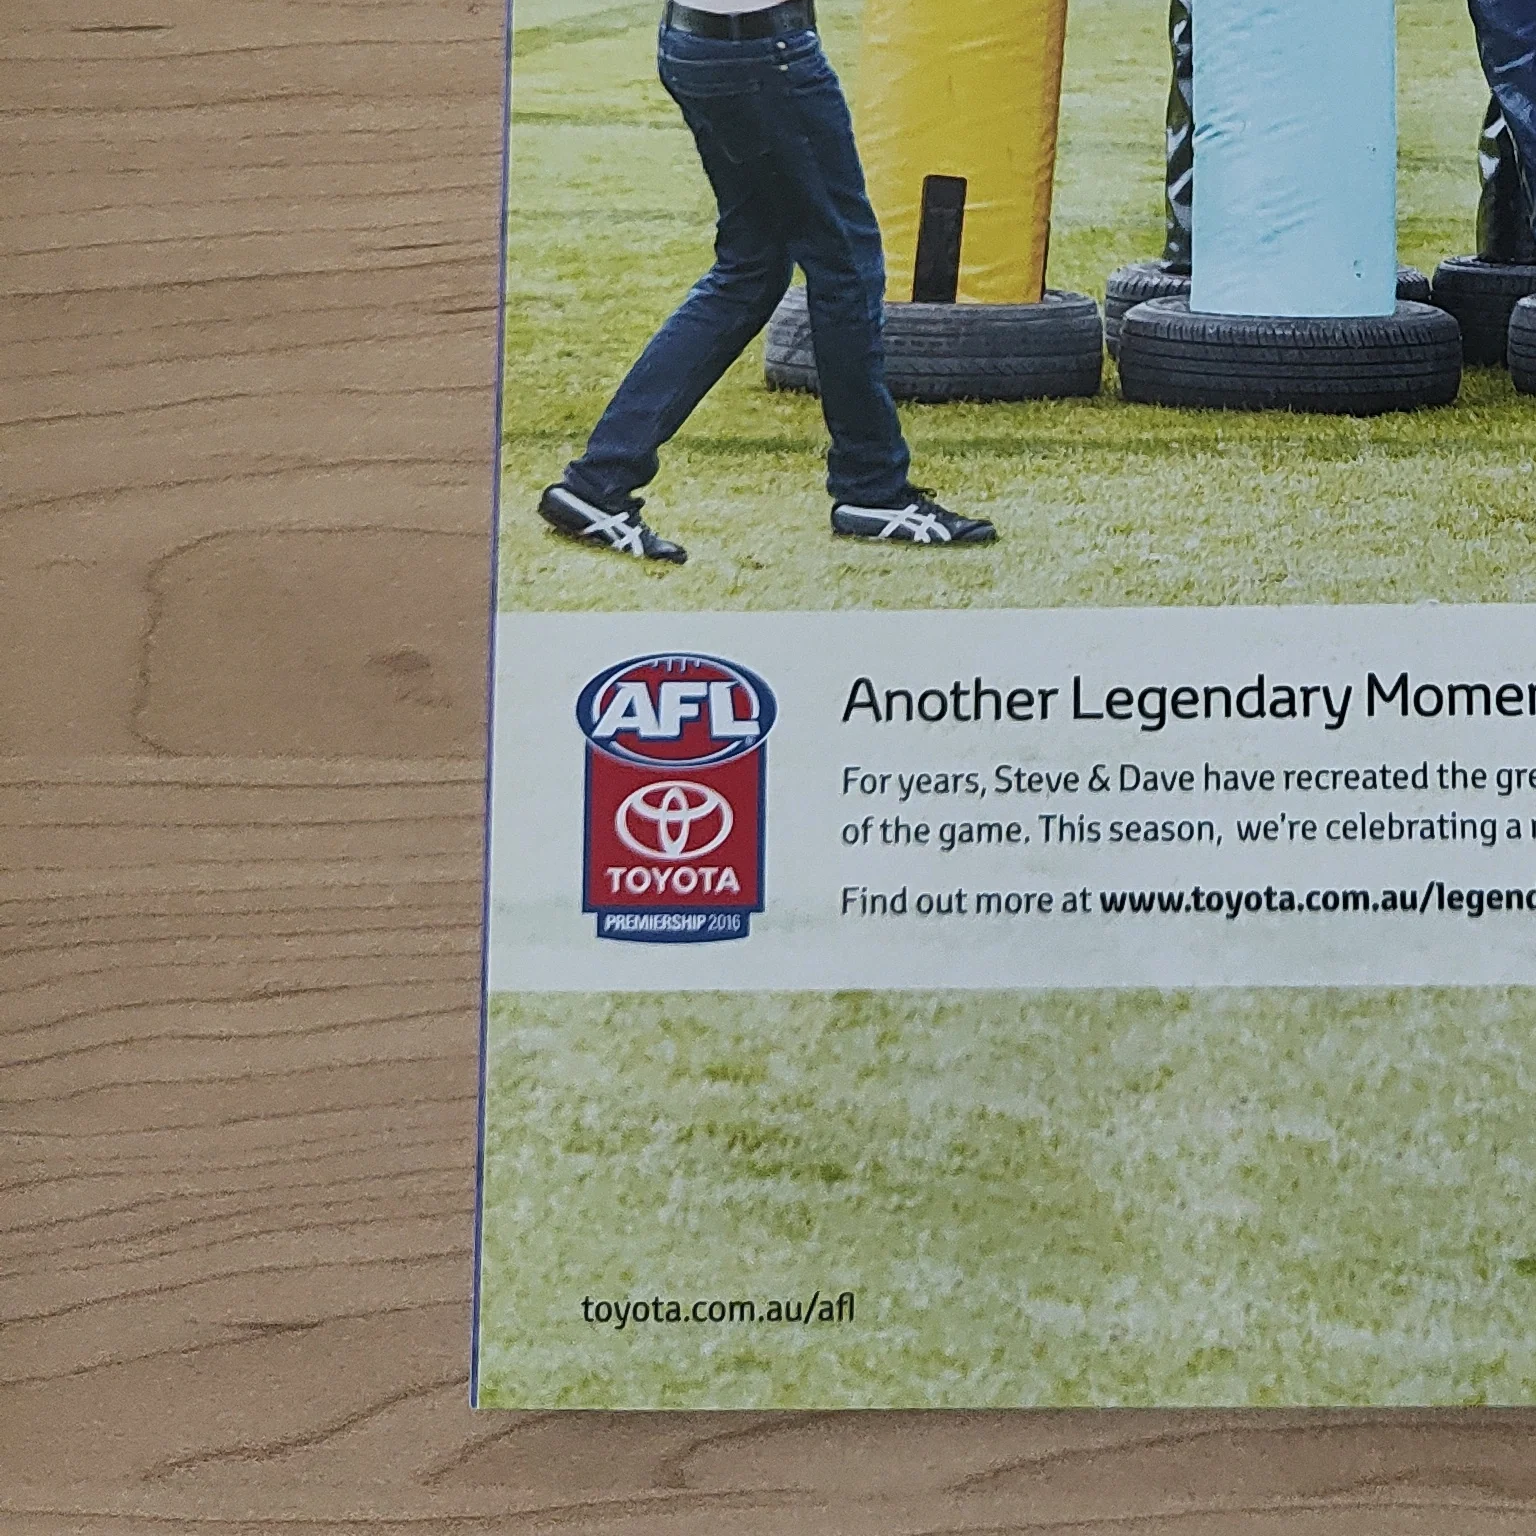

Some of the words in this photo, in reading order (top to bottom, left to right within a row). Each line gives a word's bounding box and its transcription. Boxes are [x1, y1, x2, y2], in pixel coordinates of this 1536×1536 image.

[591, 681, 760, 739] AFL
[841, 676, 1060, 723] Another
[1073, 673, 1353, 731] Legendary
[842, 766, 893, 795] For
[898, 772, 987, 802] years,
[994, 764, 1080, 794] Steve
[1087, 763, 1111, 793] &
[1119, 763, 1195, 793] Dave
[1204, 762, 1276, 792] have
[1283, 760, 1429, 792] recreated
[1436, 760, 1487, 790] the
[842, 816, 875, 846] of
[879, 815, 931, 845] the
[939, 821, 1030, 853] game.
[1038, 813, 1101, 844] This
[1108, 820, 1223, 847] season,
[1326, 811, 1497, 848] celebrating
[1505, 818, 1522, 840] a
[607, 866, 740, 895] TOYOTA
[841, 885, 908, 916] Find
[915, 888, 968, 916] out
[975, 892, 1054, 915] more
[1061, 887, 1092, 914] at
[603, 913, 707, 933] PREMIERSHIP
[707, 913, 741, 932] 2016
[581, 1290, 855, 1330] toyota.com.au/afl
